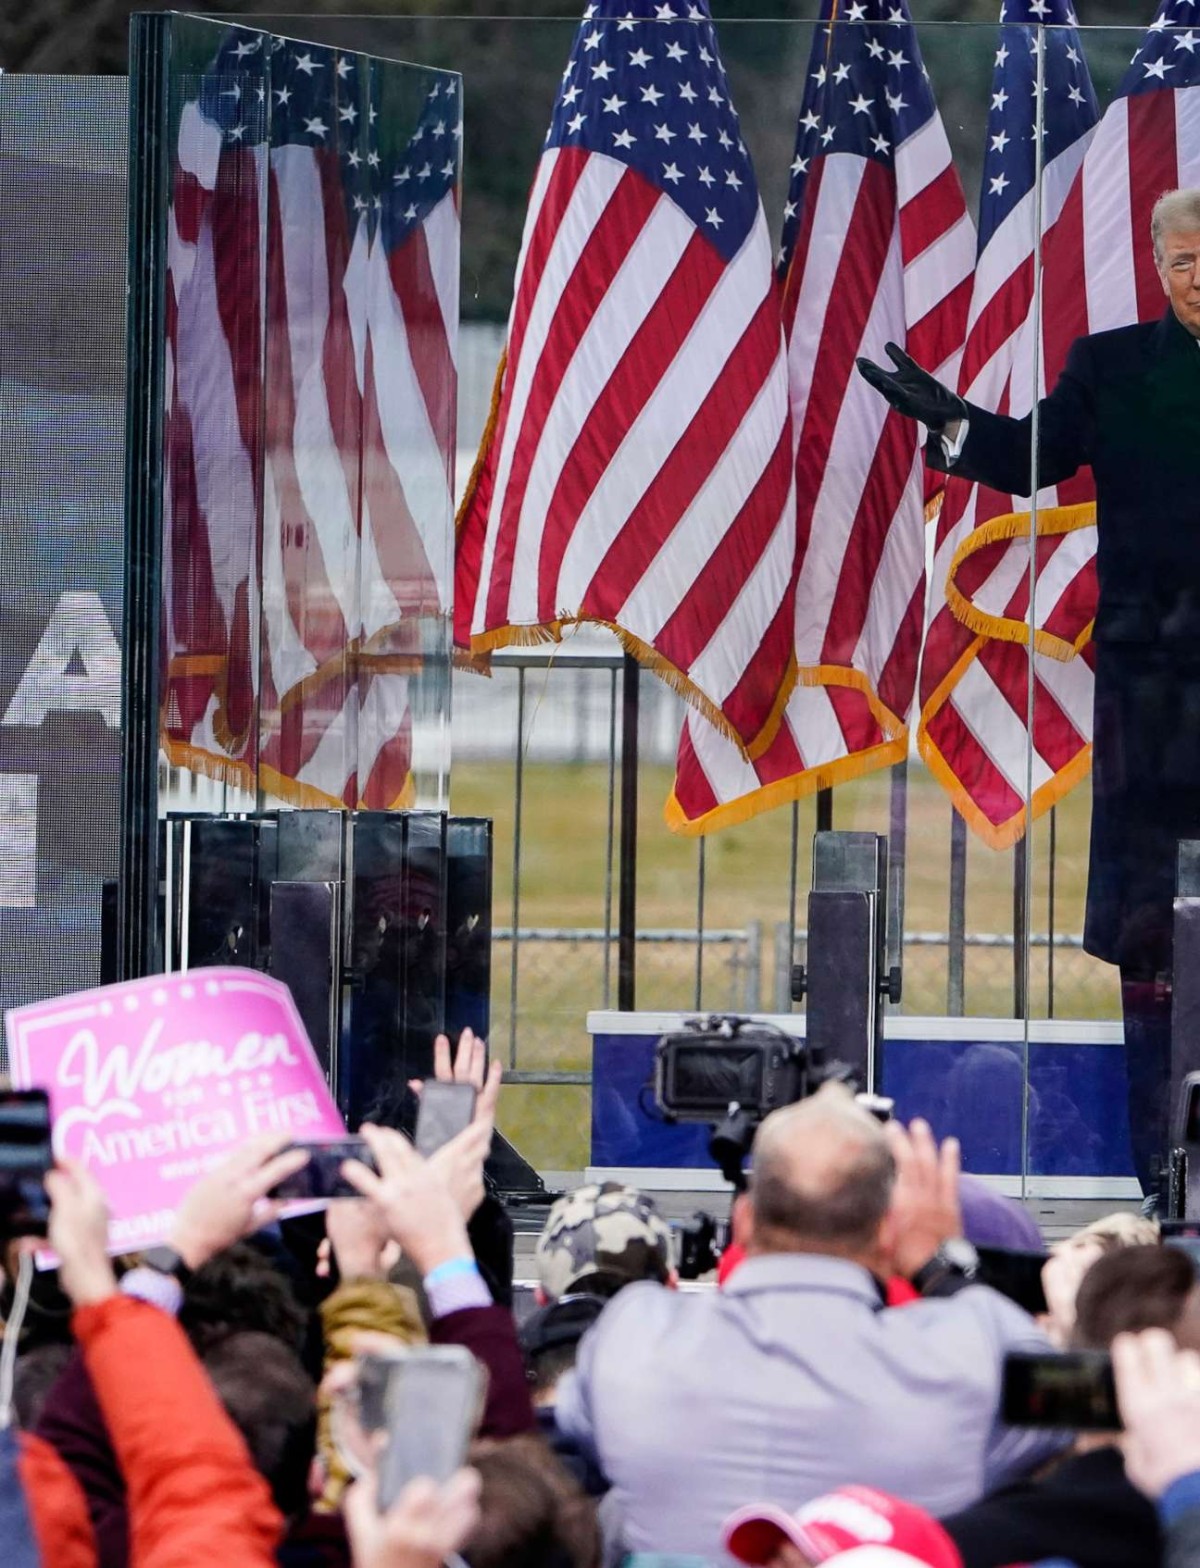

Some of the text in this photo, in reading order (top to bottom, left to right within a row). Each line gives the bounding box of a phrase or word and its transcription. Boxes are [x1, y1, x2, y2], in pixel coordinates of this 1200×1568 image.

[56, 1017, 298, 1106] Women
[54, 1100, 236, 1169] America
[243, 1089, 323, 1132] First
